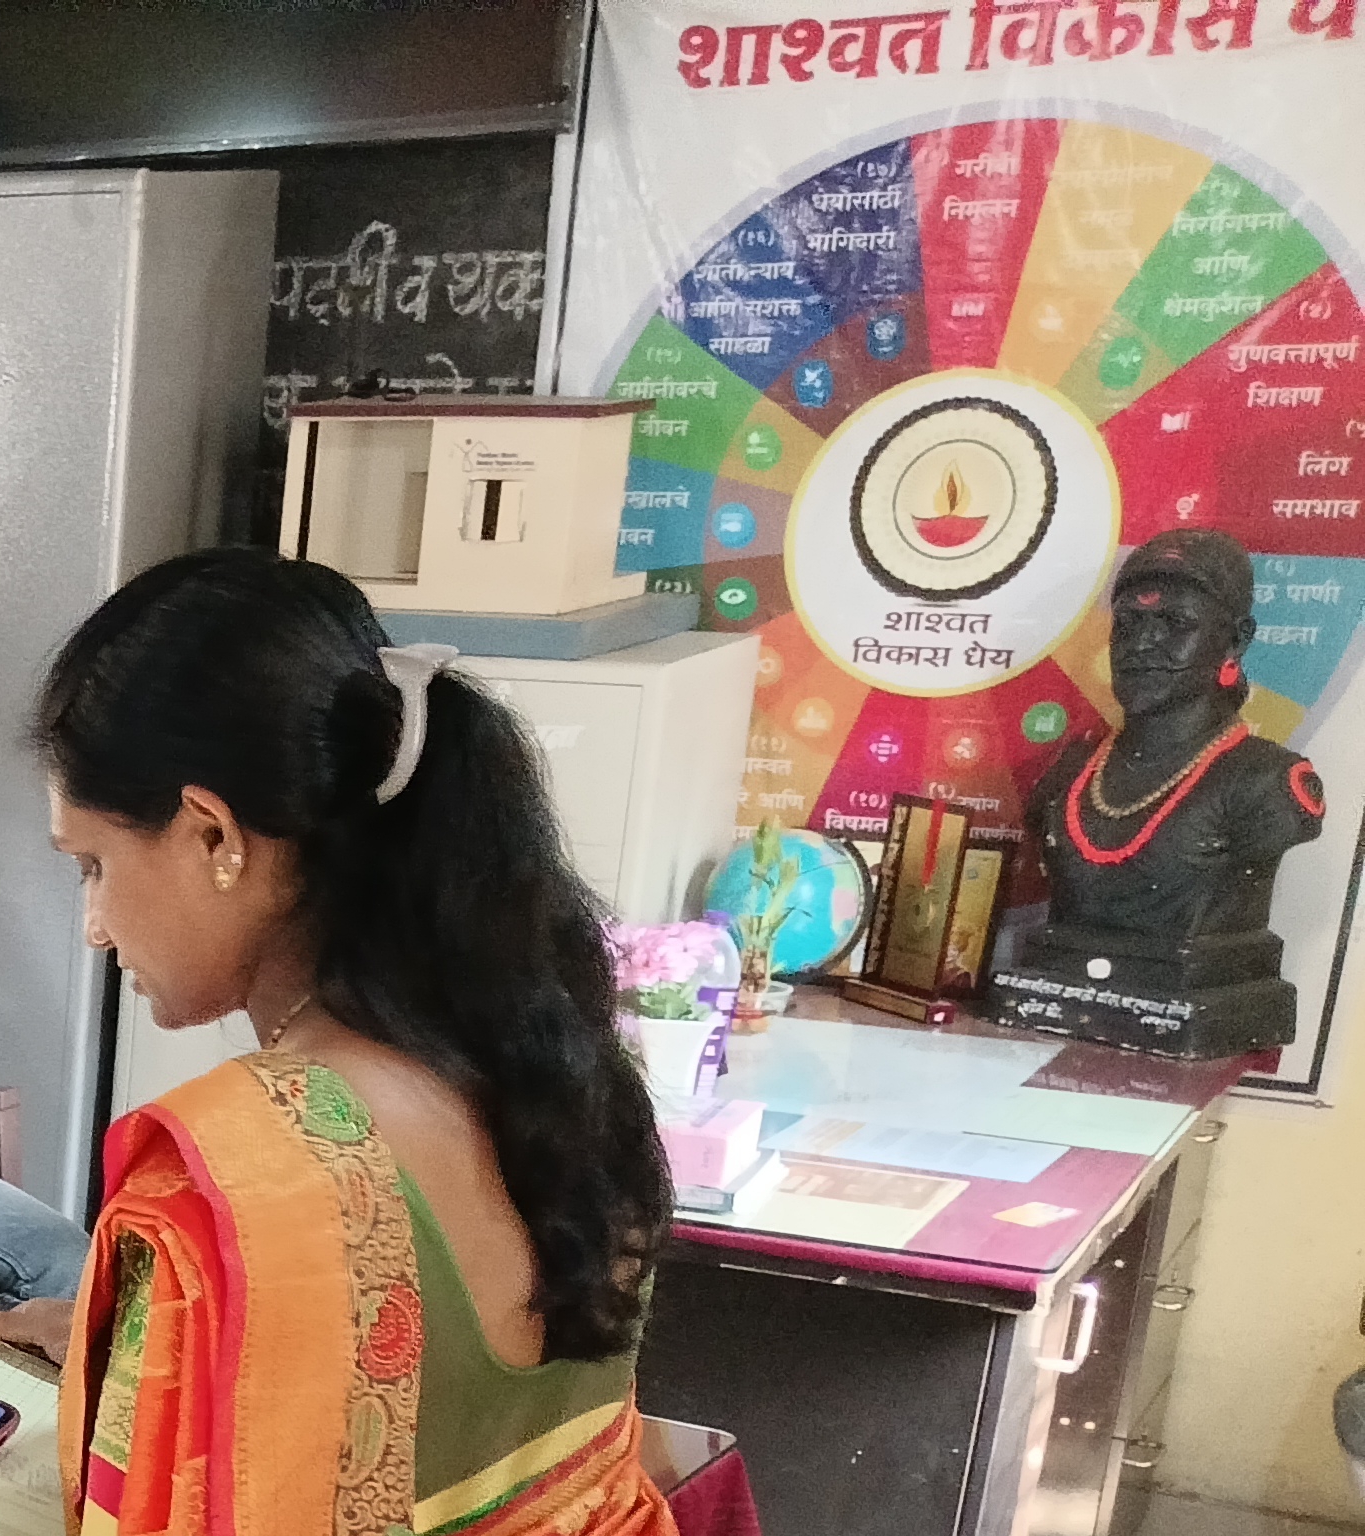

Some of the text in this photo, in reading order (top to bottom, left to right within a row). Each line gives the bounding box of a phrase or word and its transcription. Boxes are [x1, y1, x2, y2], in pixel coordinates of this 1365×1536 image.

[677, 8, 951, 89] शाश्वत
[965, 0, 1259, 71] विकास
[1246, 381, 1325, 408] शिक्षण
[638, 415, 690, 437] जीवन
[1298, 450, 1353, 477] लिंग
[1272, 498, 1361, 519] समभाव
[883, 611, 992, 634] शाश्वत
[852, 636, 1015, 670] विकास धेय
[824, 807, 889, 833] विषमत
